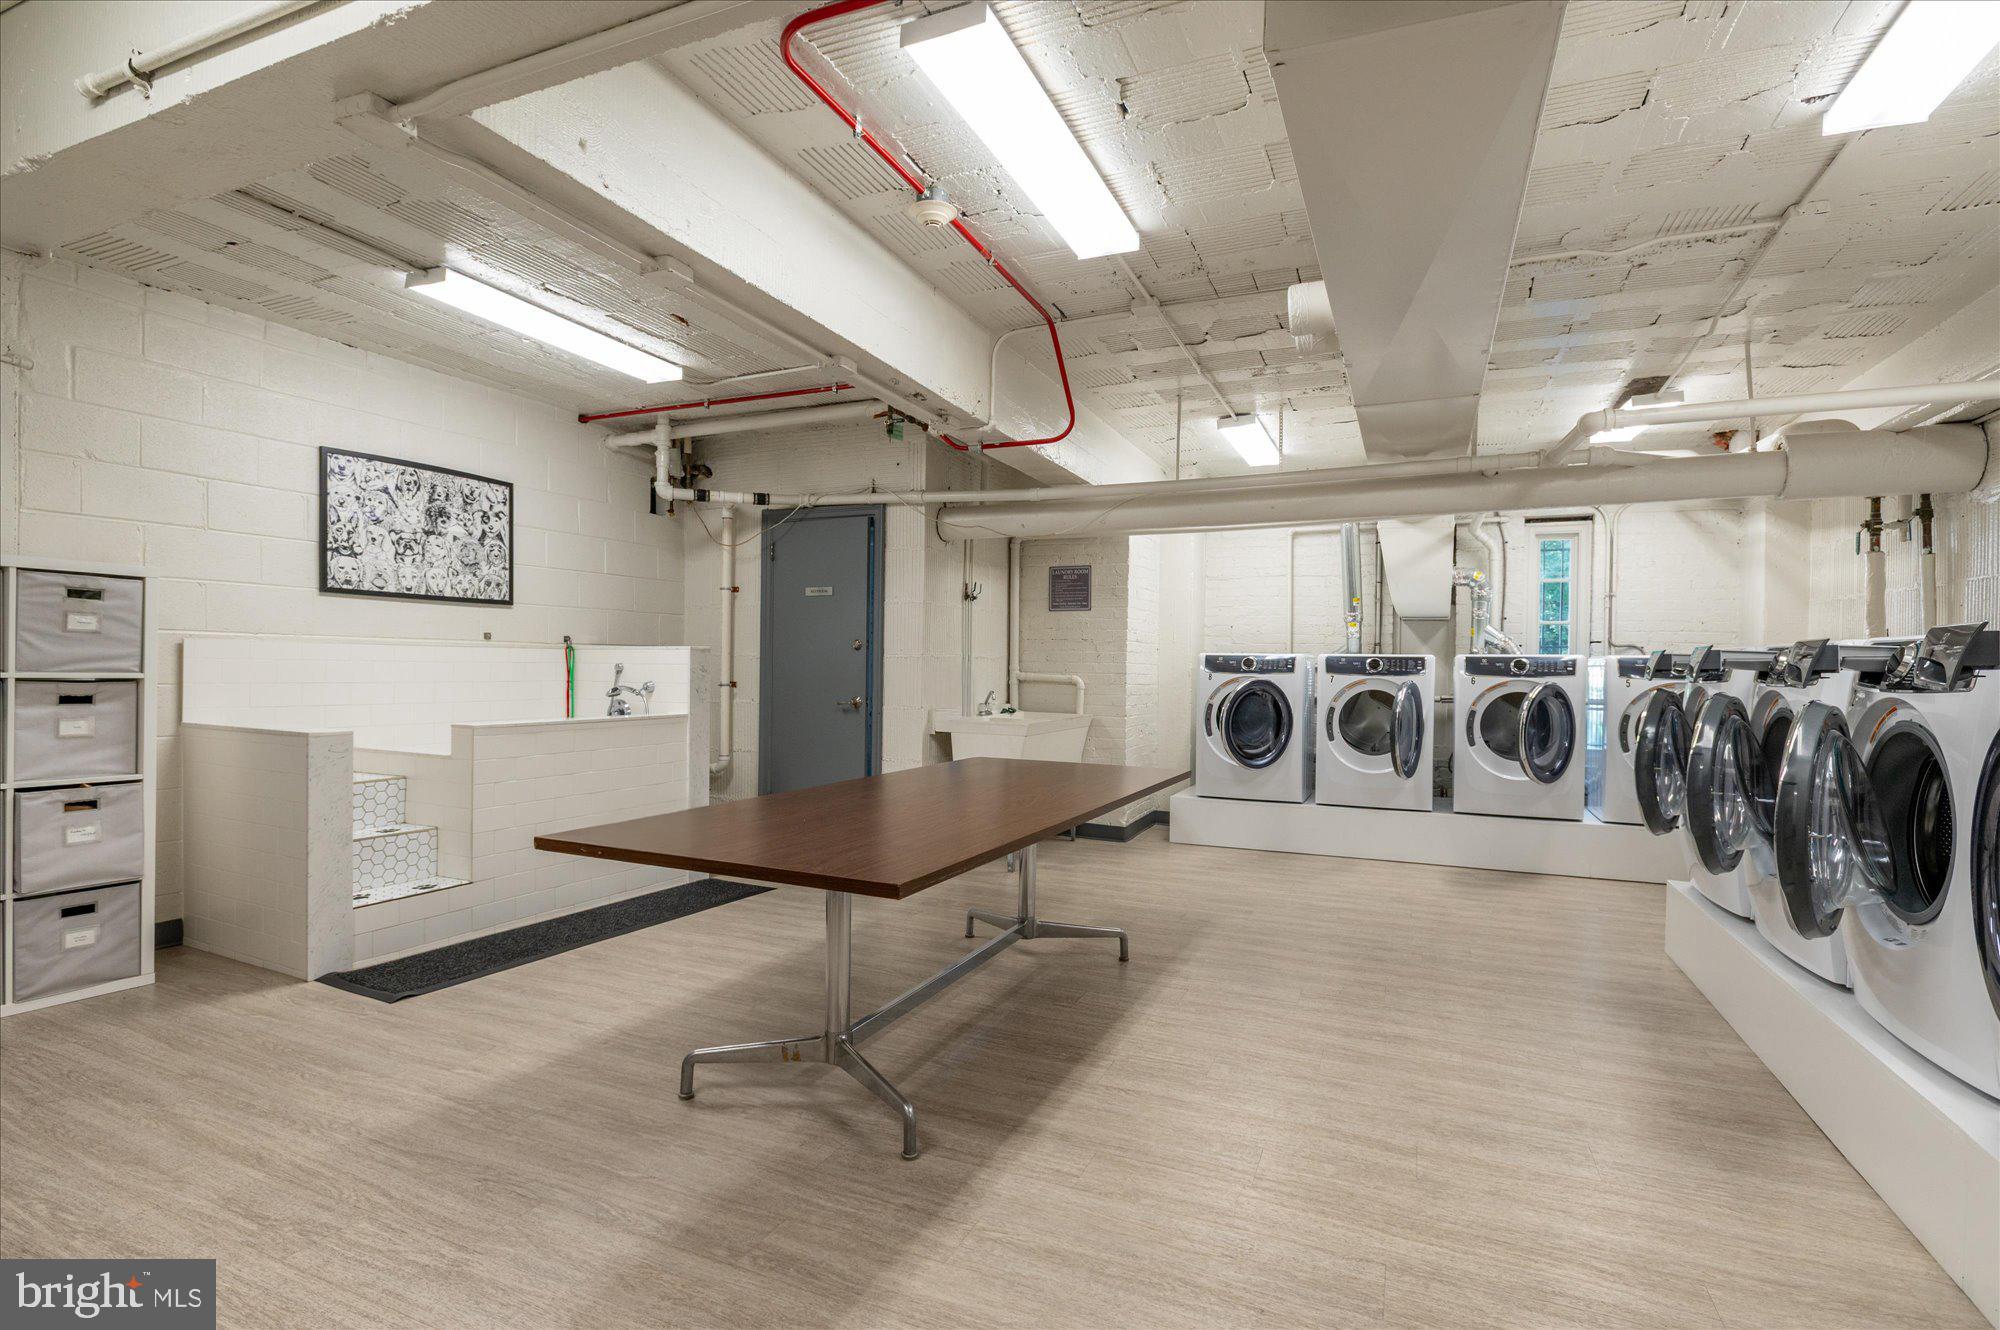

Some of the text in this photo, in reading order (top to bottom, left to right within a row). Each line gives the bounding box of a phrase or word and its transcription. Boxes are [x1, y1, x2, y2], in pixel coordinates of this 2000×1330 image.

[1330, 675, 1335, 684] 7
[1470, 676, 1476, 685] 6
[1625, 679, 1631, 688] 5
